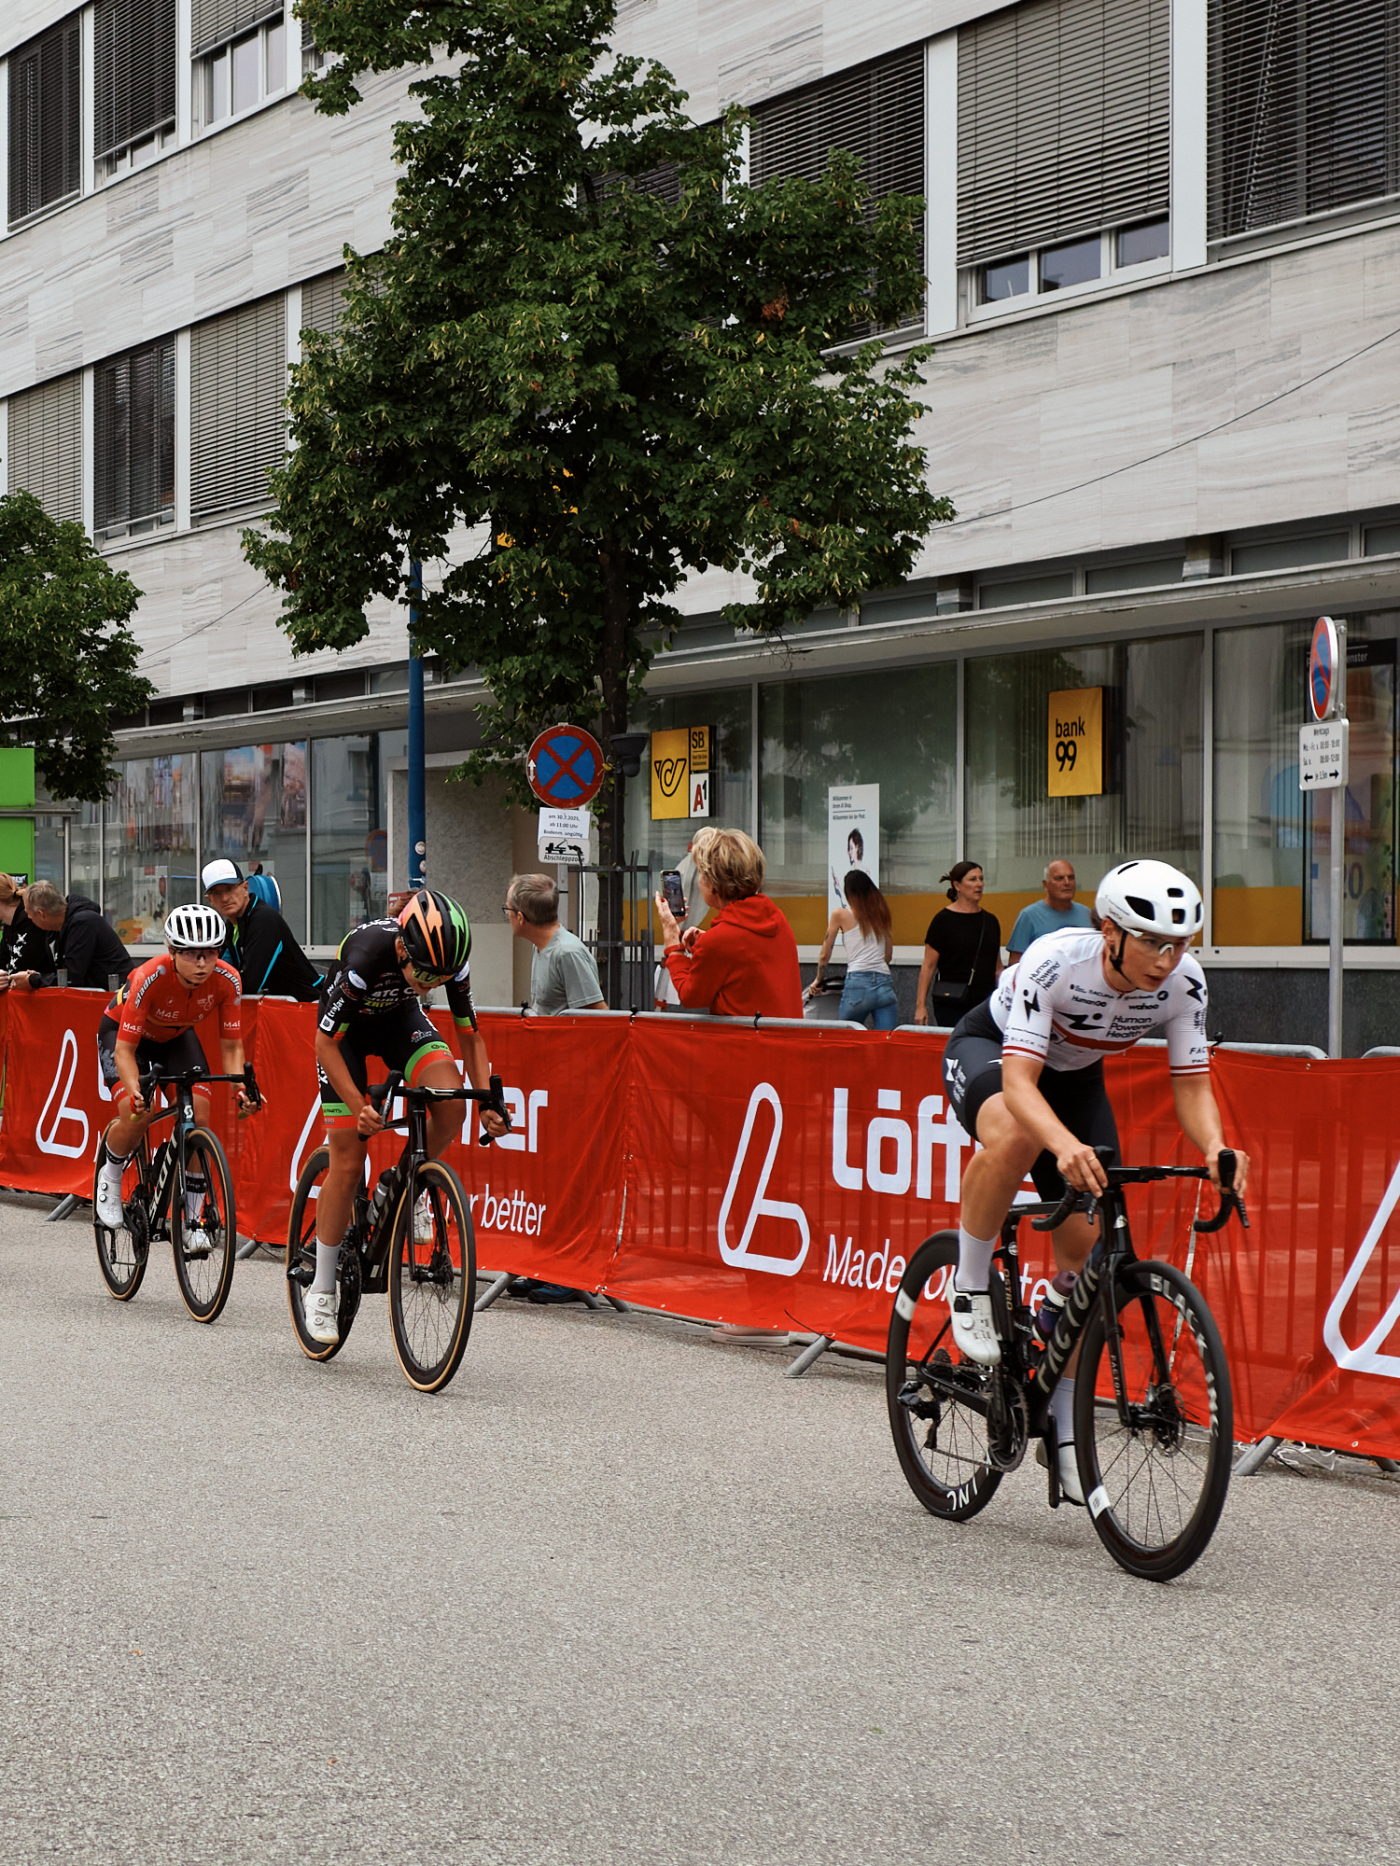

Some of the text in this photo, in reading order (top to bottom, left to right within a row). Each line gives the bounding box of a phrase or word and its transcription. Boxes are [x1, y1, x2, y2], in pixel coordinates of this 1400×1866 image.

[692, 731, 704, 749] SB
[1055, 715, 1085, 738] bank
[1055, 740, 1077, 772] 99
[693, 780, 707, 812] A1
[134, 969, 161, 1009] stadler
[122, 1021, 142, 1033] M4E
[155, 1008, 179, 1019] M4E
[1113, 1015, 1152, 1023] Human
[149, 1127, 178, 1225] SCOTT
[480, 1183, 547, 1237] better
[822, 1233, 907, 1294] Made
[1003, 1268, 1014, 1312] OSTRO
[1150, 1272, 1208, 1358] BLACK
[1109, 1354, 1123, 1398] FACTOR
